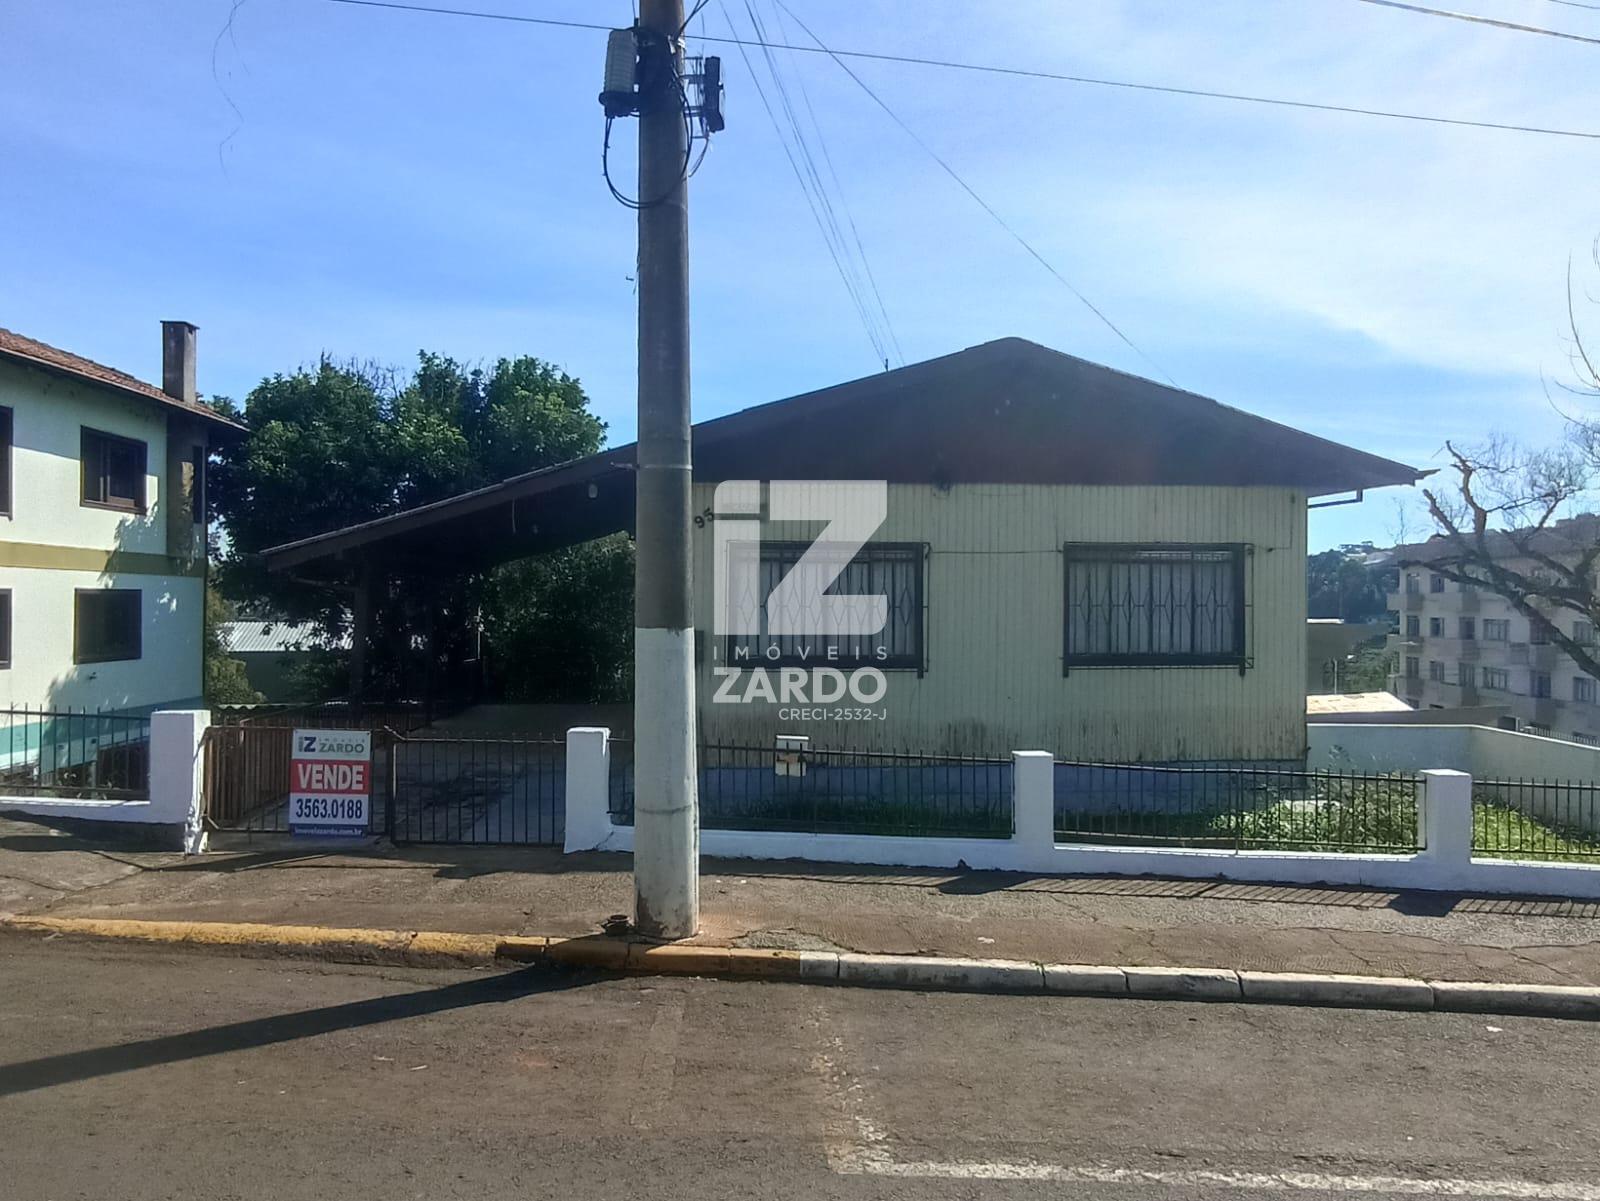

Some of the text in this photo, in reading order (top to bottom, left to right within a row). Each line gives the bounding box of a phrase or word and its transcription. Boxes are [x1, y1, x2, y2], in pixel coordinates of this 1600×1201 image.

[319, 742, 365, 753] ZARDO
[298, 763, 364, 790] VENDE
[296, 798, 363, 819] 3563.0188
